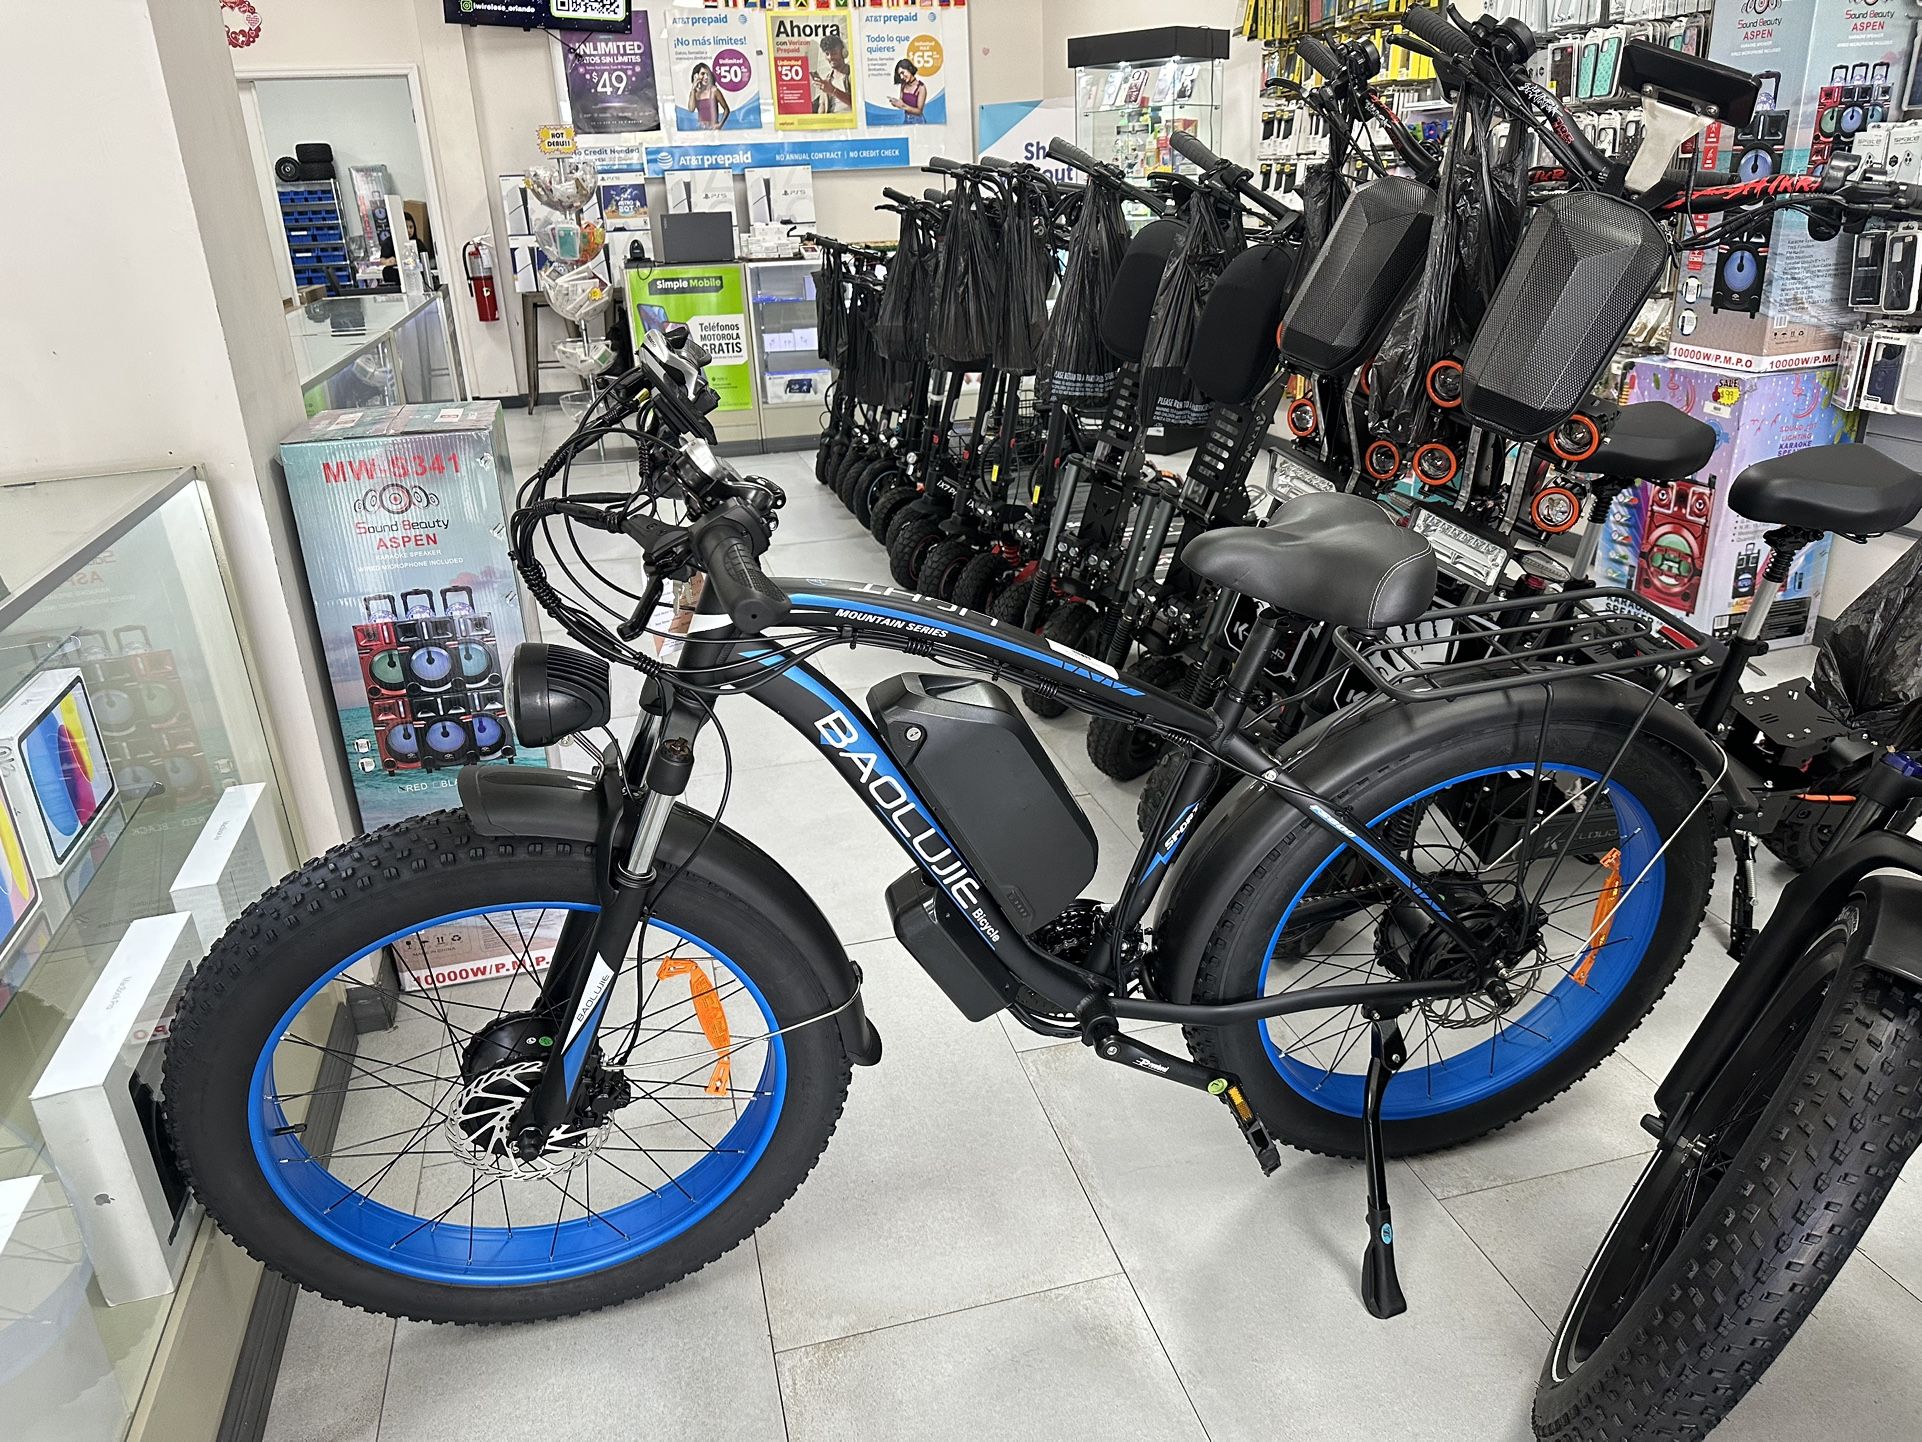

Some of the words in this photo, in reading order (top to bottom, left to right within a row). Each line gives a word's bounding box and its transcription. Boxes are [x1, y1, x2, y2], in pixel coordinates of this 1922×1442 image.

[672, 17, 690, 25] AT&T
[691, 14, 728, 26] prepaid
[883, 12, 918, 24] prepaid
[1845, 10, 1868, 20] Sound
[1869, 10, 1895, 19] Beauty
[775, 19, 840, 38] Ahorra
[1737, 19, 1758, 29] Sound
[1759, 17, 1782, 28] Beauty
[1852, 21, 1885, 31] ASPEN
[866, 34, 885, 42] Todo
[887, 34, 894, 42] lo
[896, 35, 910, 44] que
[1743, 29, 1773, 40] ASPEN
[674, 36, 690, 48] ¡No
[692, 36, 711, 46] más
[713, 35, 747, 46] límites!
[866, 44, 895, 54] quieres
[909, 51, 934, 68] $65
[715, 65, 742, 82] $50
[778, 65, 803, 80] $50
[592, 70, 627, 95] $49
[679, 155, 703, 165] AT&T
[703, 150, 752, 167] prepaid
[776, 153, 785, 161] NO
[786, 152, 810, 160] ANNUAL
[811, 151, 841, 159] CONTRACT
[850, 150, 858, 158] NO
[859, 149, 880, 157] CREDIT
[881, 149, 899, 157] CHECK
[657, 279, 688, 290] Simple
[690, 279, 721, 287] Mobile
[699, 322, 740, 332] Teléfonos
[700, 333, 740, 342] MOTOROLA
[702, 342, 742, 354] GRATIS
[1672, 347, 1753, 369] 10000W/P.M.P.O
[1769, 353, 1840, 369] 10000W/P.M.P
[1719, 379, 1738, 387] SALE
[1781, 433, 1812, 441] LIGHTING
[1778, 440, 1812, 449] KARAOKE
[355, 521, 399, 535] Sound
[402, 519, 449, 531] Beauty
[376, 533, 438, 550] ASPEN
[376, 551, 408, 560] KARAOKE
[410, 550, 442, 558] SPEAKER
[381, 560, 428, 571] MICROPHONE
[429, 557, 463, 566] INCLUDED
[835, 609, 904, 629] MOUNTAIN
[906, 623, 949, 638] SERIES
[406, 783, 428, 792] RED
[814, 710, 979, 909] BAOLUJIE
[1164, 802, 1200, 850] SPORT
[972, 907, 1000, 942] Bicycle
[415, 955, 550, 985] 10000W/P.M.P.
[576, 974, 610, 1022] BAOLUJIE
